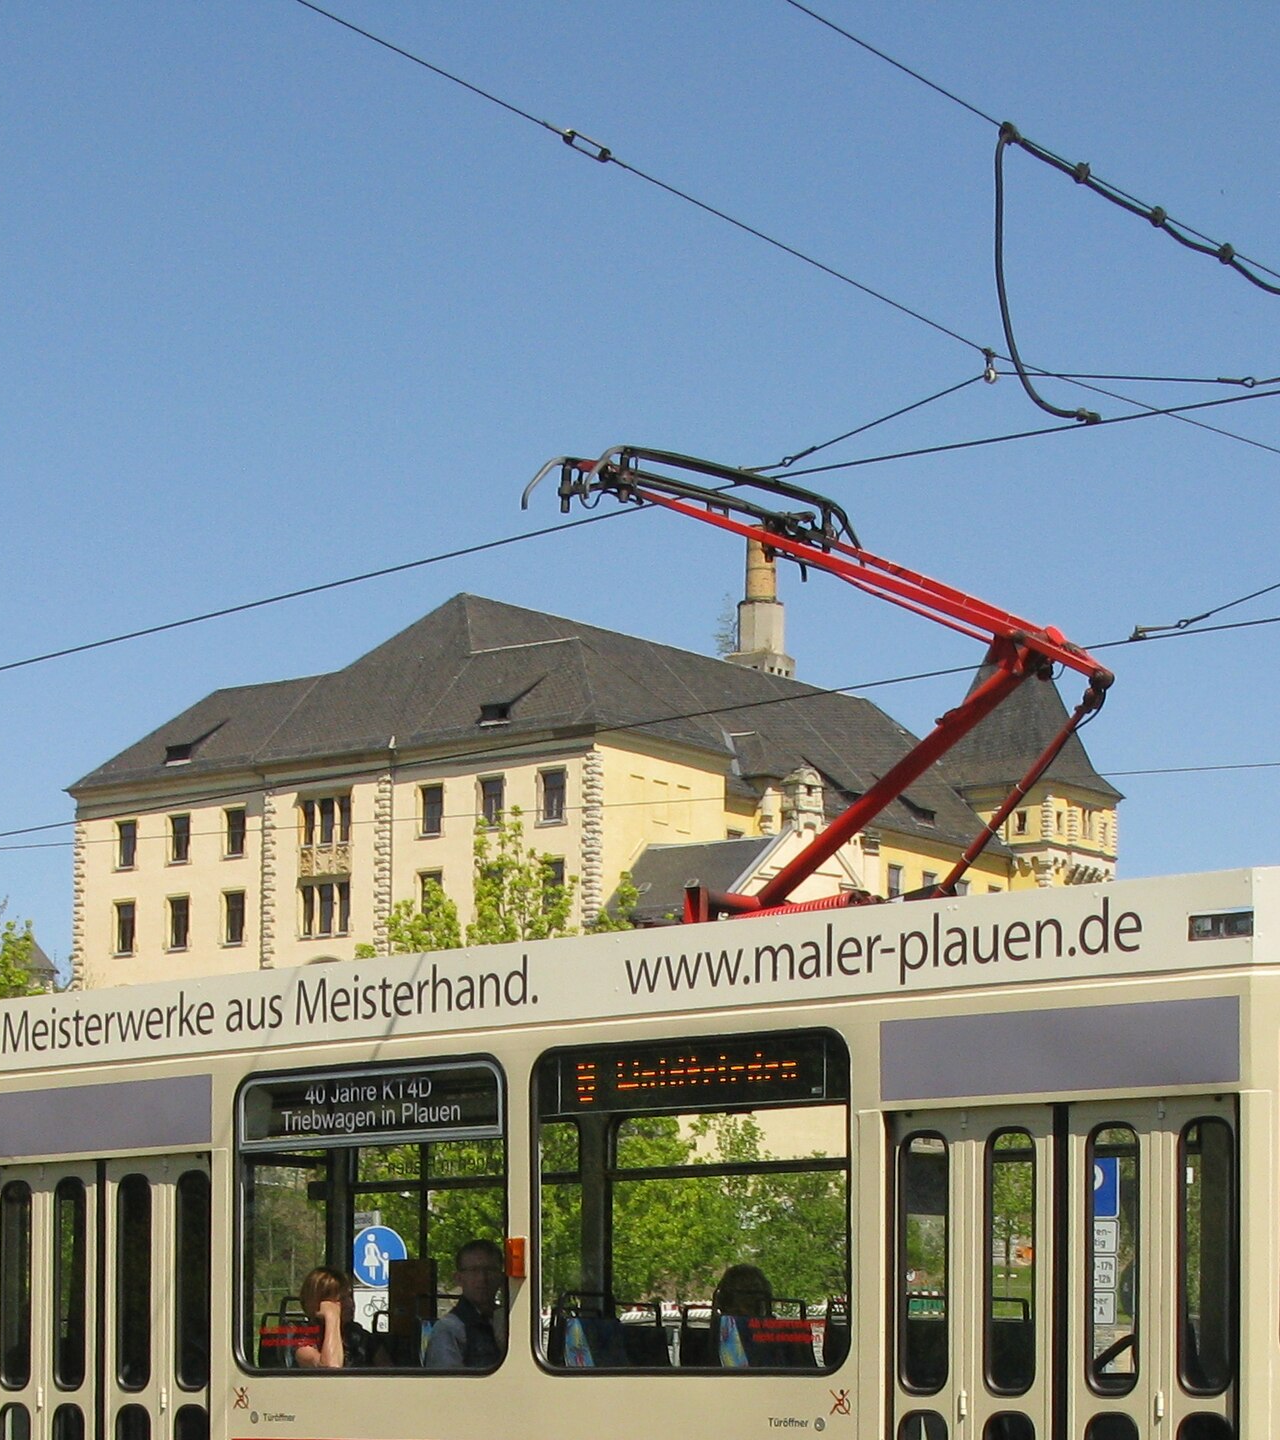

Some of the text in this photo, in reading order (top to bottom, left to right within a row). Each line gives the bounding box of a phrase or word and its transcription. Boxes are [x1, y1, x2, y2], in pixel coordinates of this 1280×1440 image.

[624, 896, 1144, 996] www.maler-plauen.de
[0, 955, 540, 1055] Meisterwerke aus Meisterhand.
[304, 1077, 432, 1105] 40 Jahre KT4D
[281, 1102, 461, 1133] Triebwagen in Plauen
[768, 1416, 809, 1428] Türöffner
